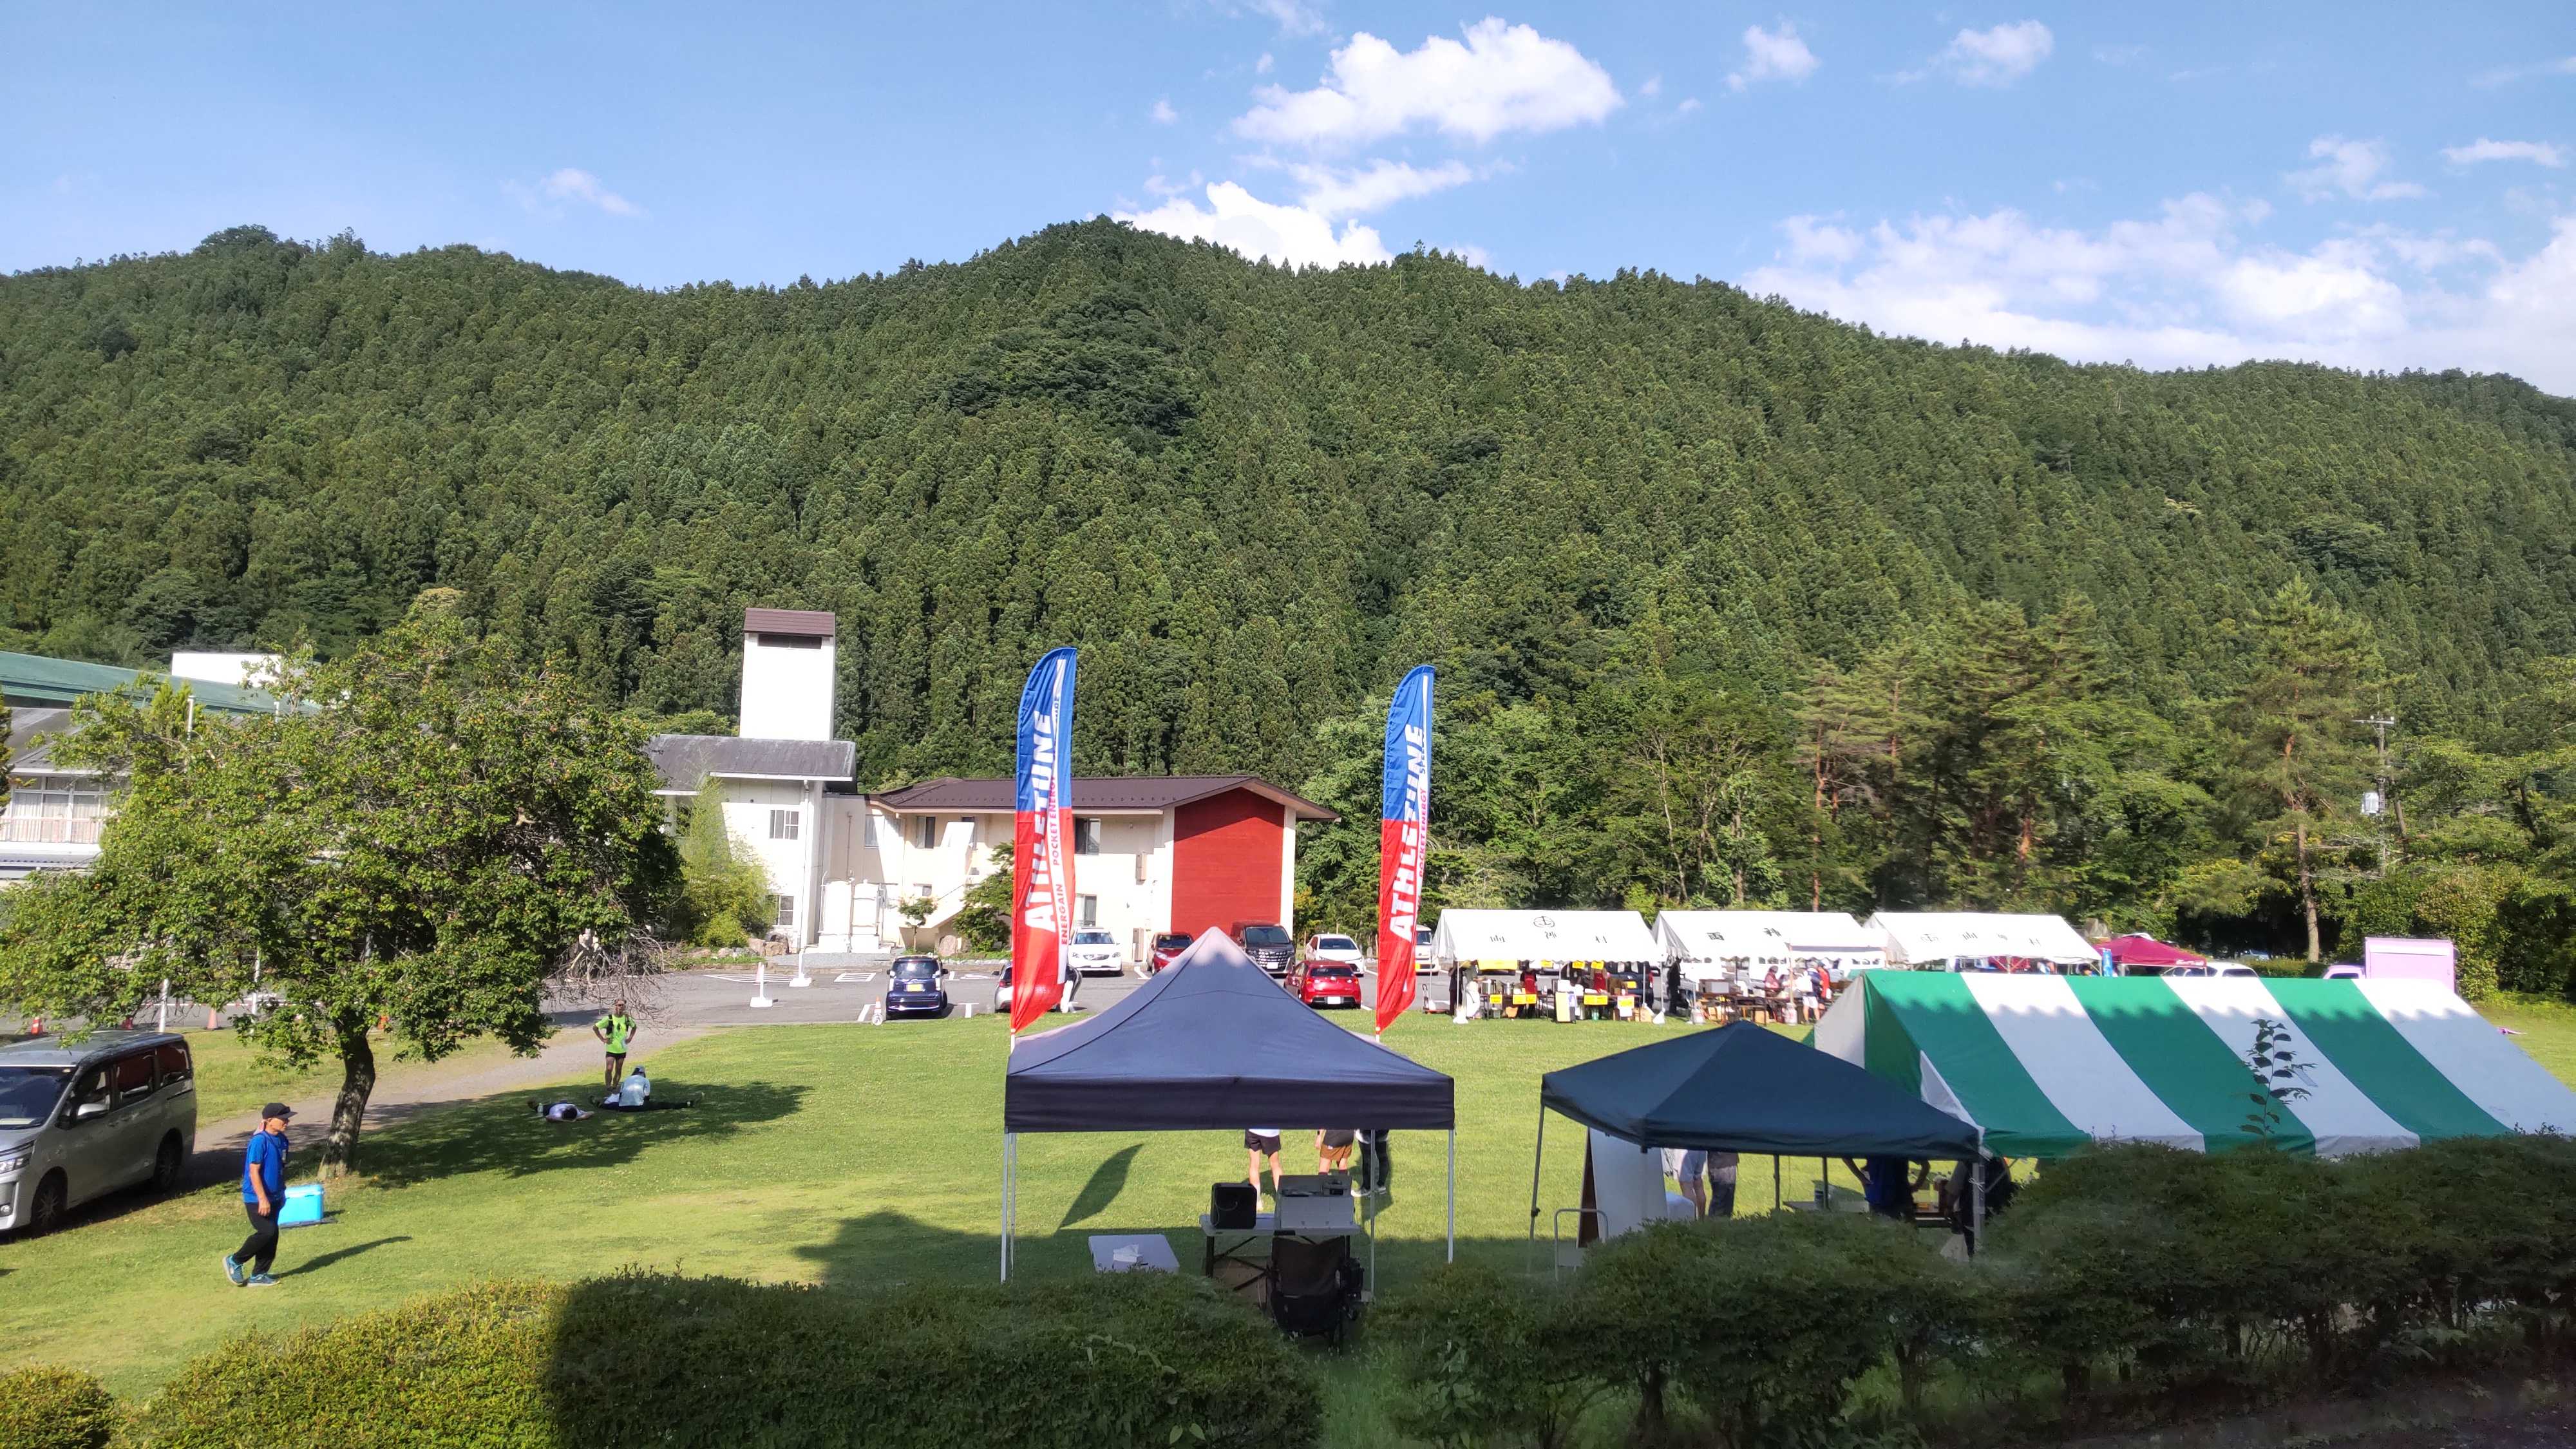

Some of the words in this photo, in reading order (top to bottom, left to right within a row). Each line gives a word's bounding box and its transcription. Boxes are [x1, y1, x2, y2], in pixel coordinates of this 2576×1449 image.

[1025, 710, 1056, 933] ATHLETUNE
[1049, 776, 1057, 819] ENERGY
[1419, 788, 1427, 830] ENERGY
[1050, 822, 1060, 866] POCKET
[1389, 724, 1423, 943] ATHLETUNE
[1056, 884, 1069, 945] ENERGAIN
